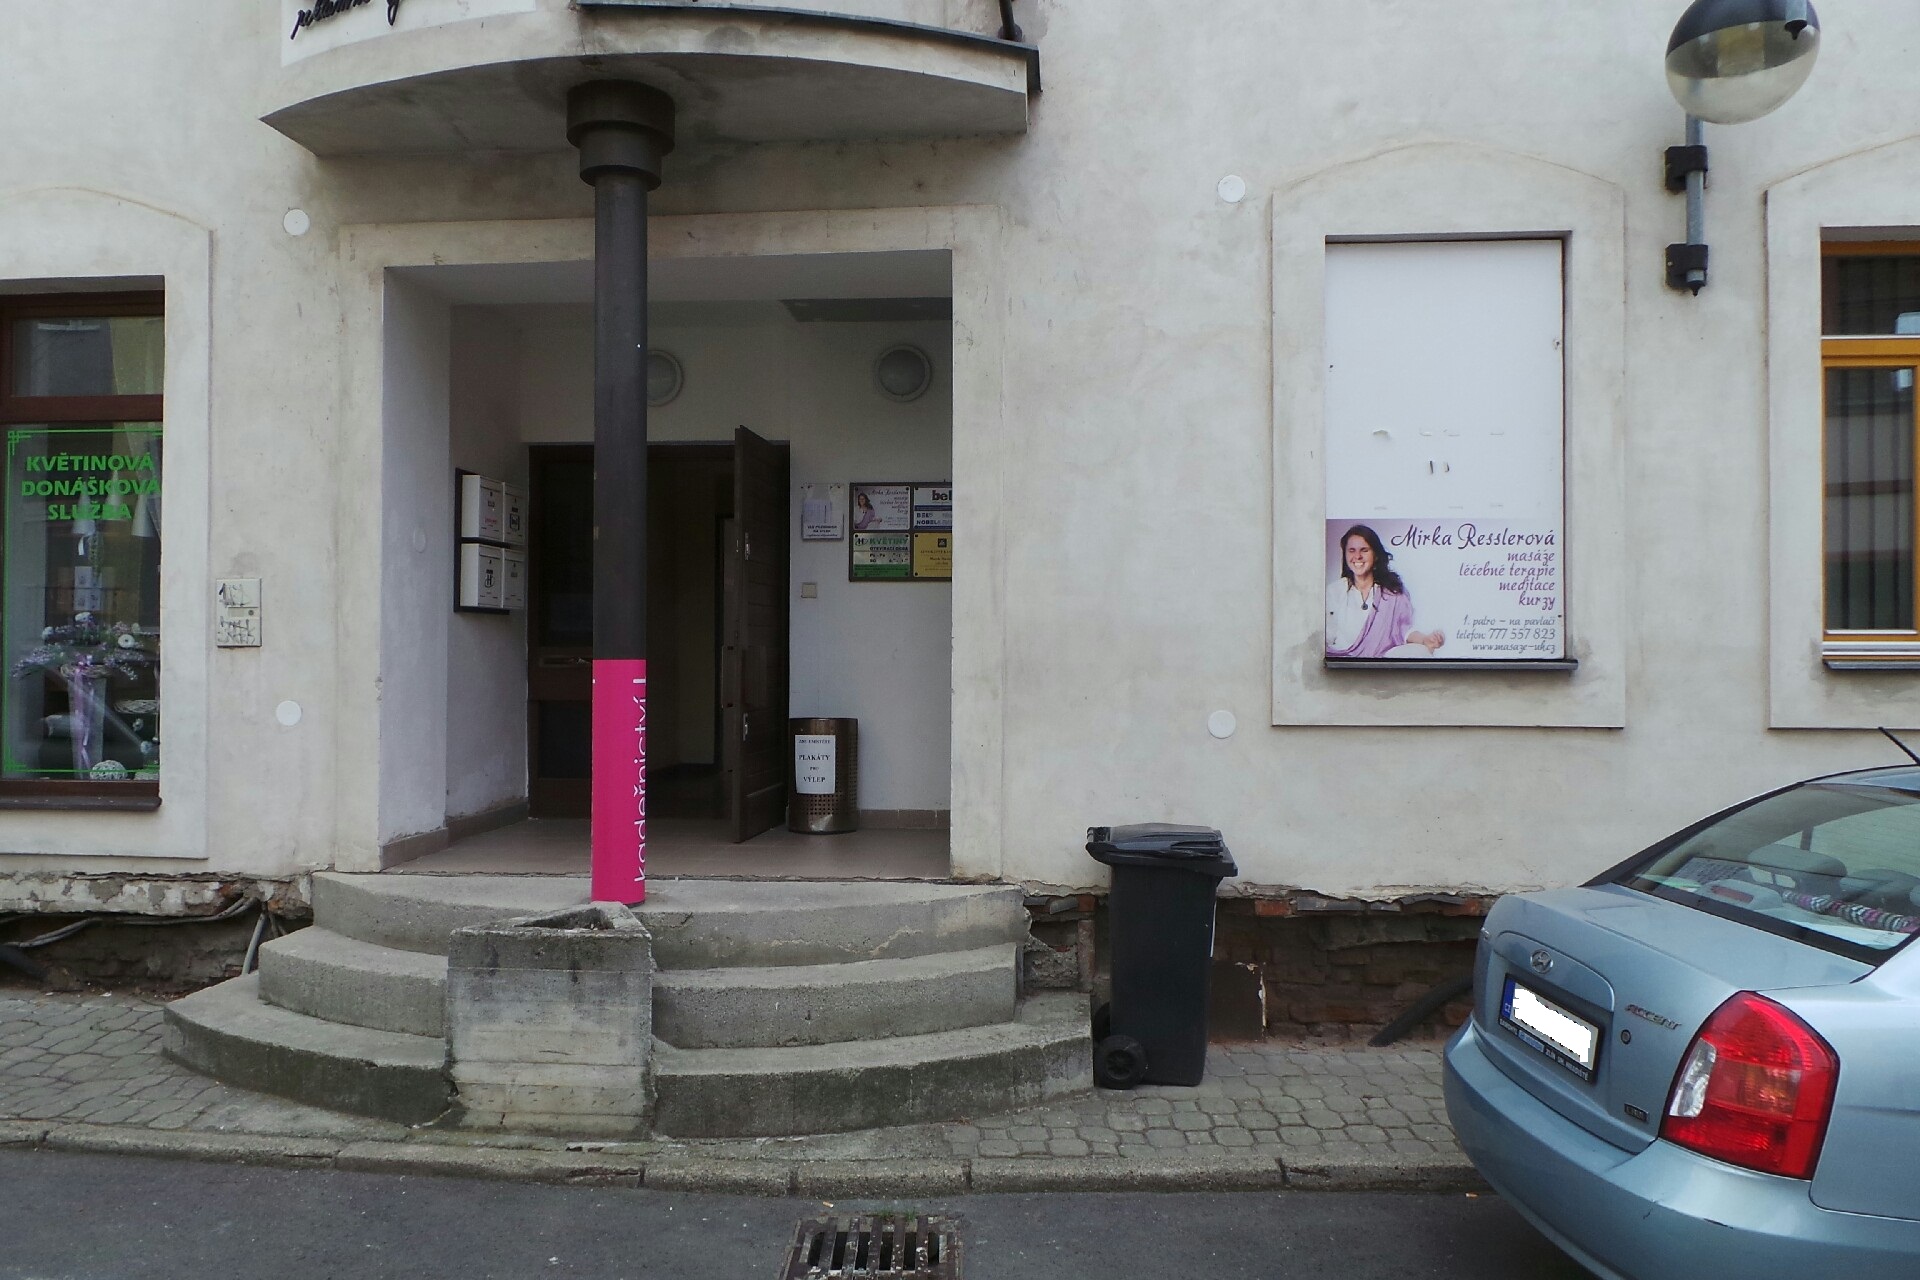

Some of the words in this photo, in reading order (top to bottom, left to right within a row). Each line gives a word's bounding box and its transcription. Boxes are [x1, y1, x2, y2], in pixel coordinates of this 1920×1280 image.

[26, 452, 154, 471] KVĚTINOVÁ
[1391, 524, 1452, 549] Mirka
[1457, 523, 1555, 549] Resslerová
[1507, 550, 1555, 566] masáže
[1459, 561, 1505, 576] léčebné
[1509, 563, 1555, 580] terapie
[1499, 575, 1555, 592] meditace
[1519, 590, 1555, 611] kurzy
[1472, 616, 1496, 628] patro
[1509, 618, 1521, 626] na
[1489, 628, 1508, 640] 777
[1510, 628, 1531, 640] 557
[1533, 628, 1555, 640] 823
[798, 753, 831, 761] PLAKÁTY
[803, 775, 826, 783] VÝLEP
